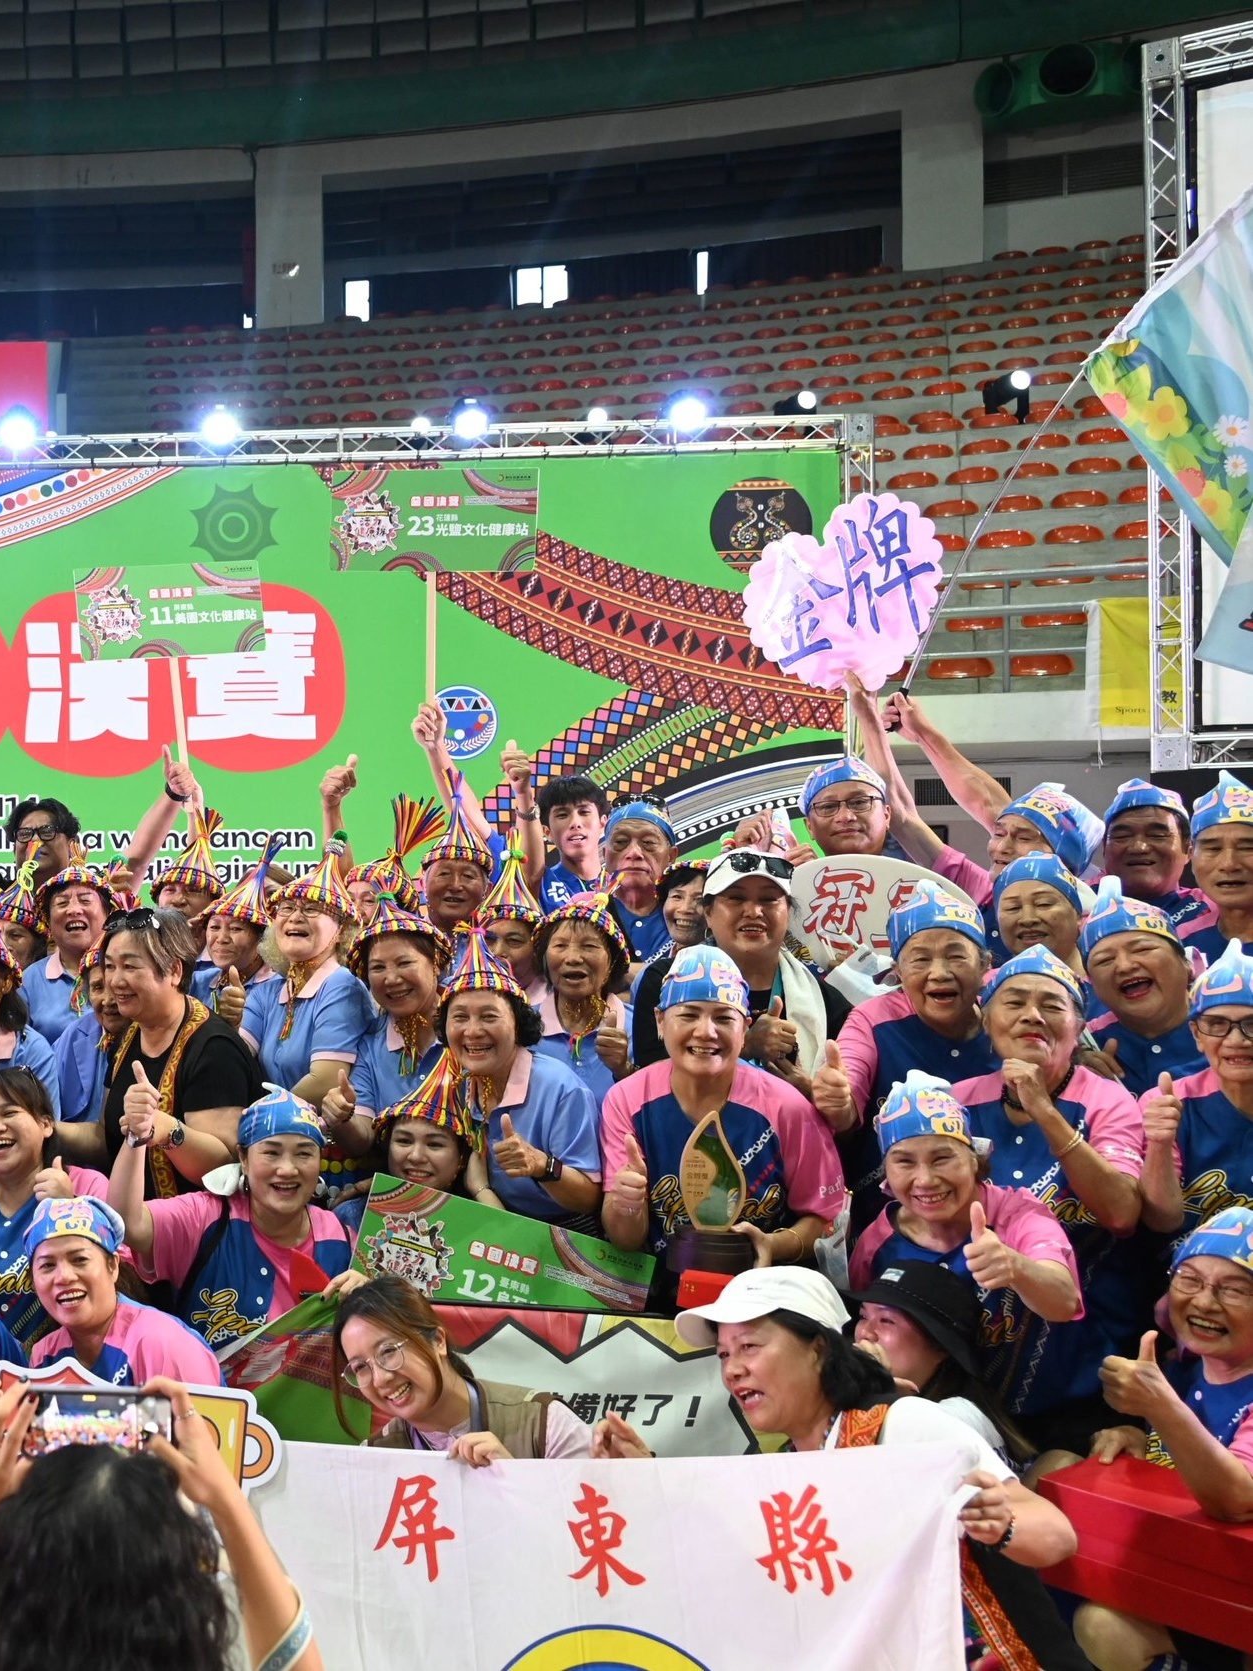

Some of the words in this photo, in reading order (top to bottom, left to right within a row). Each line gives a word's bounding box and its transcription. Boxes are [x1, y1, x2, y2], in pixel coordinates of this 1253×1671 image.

[407, 516, 434, 536] 23
[435, 523, 529, 537] 光鹽文化健康站
[762, 499, 935, 667] 金牌
[149, 606, 175, 626] 11
[1115, 707, 1146, 715] Sports
[457, 1269, 496, 1302] 12
[499, 1276, 531, 1295] 臺東縣
[374, 1475, 853, 1599] 屏東縣
